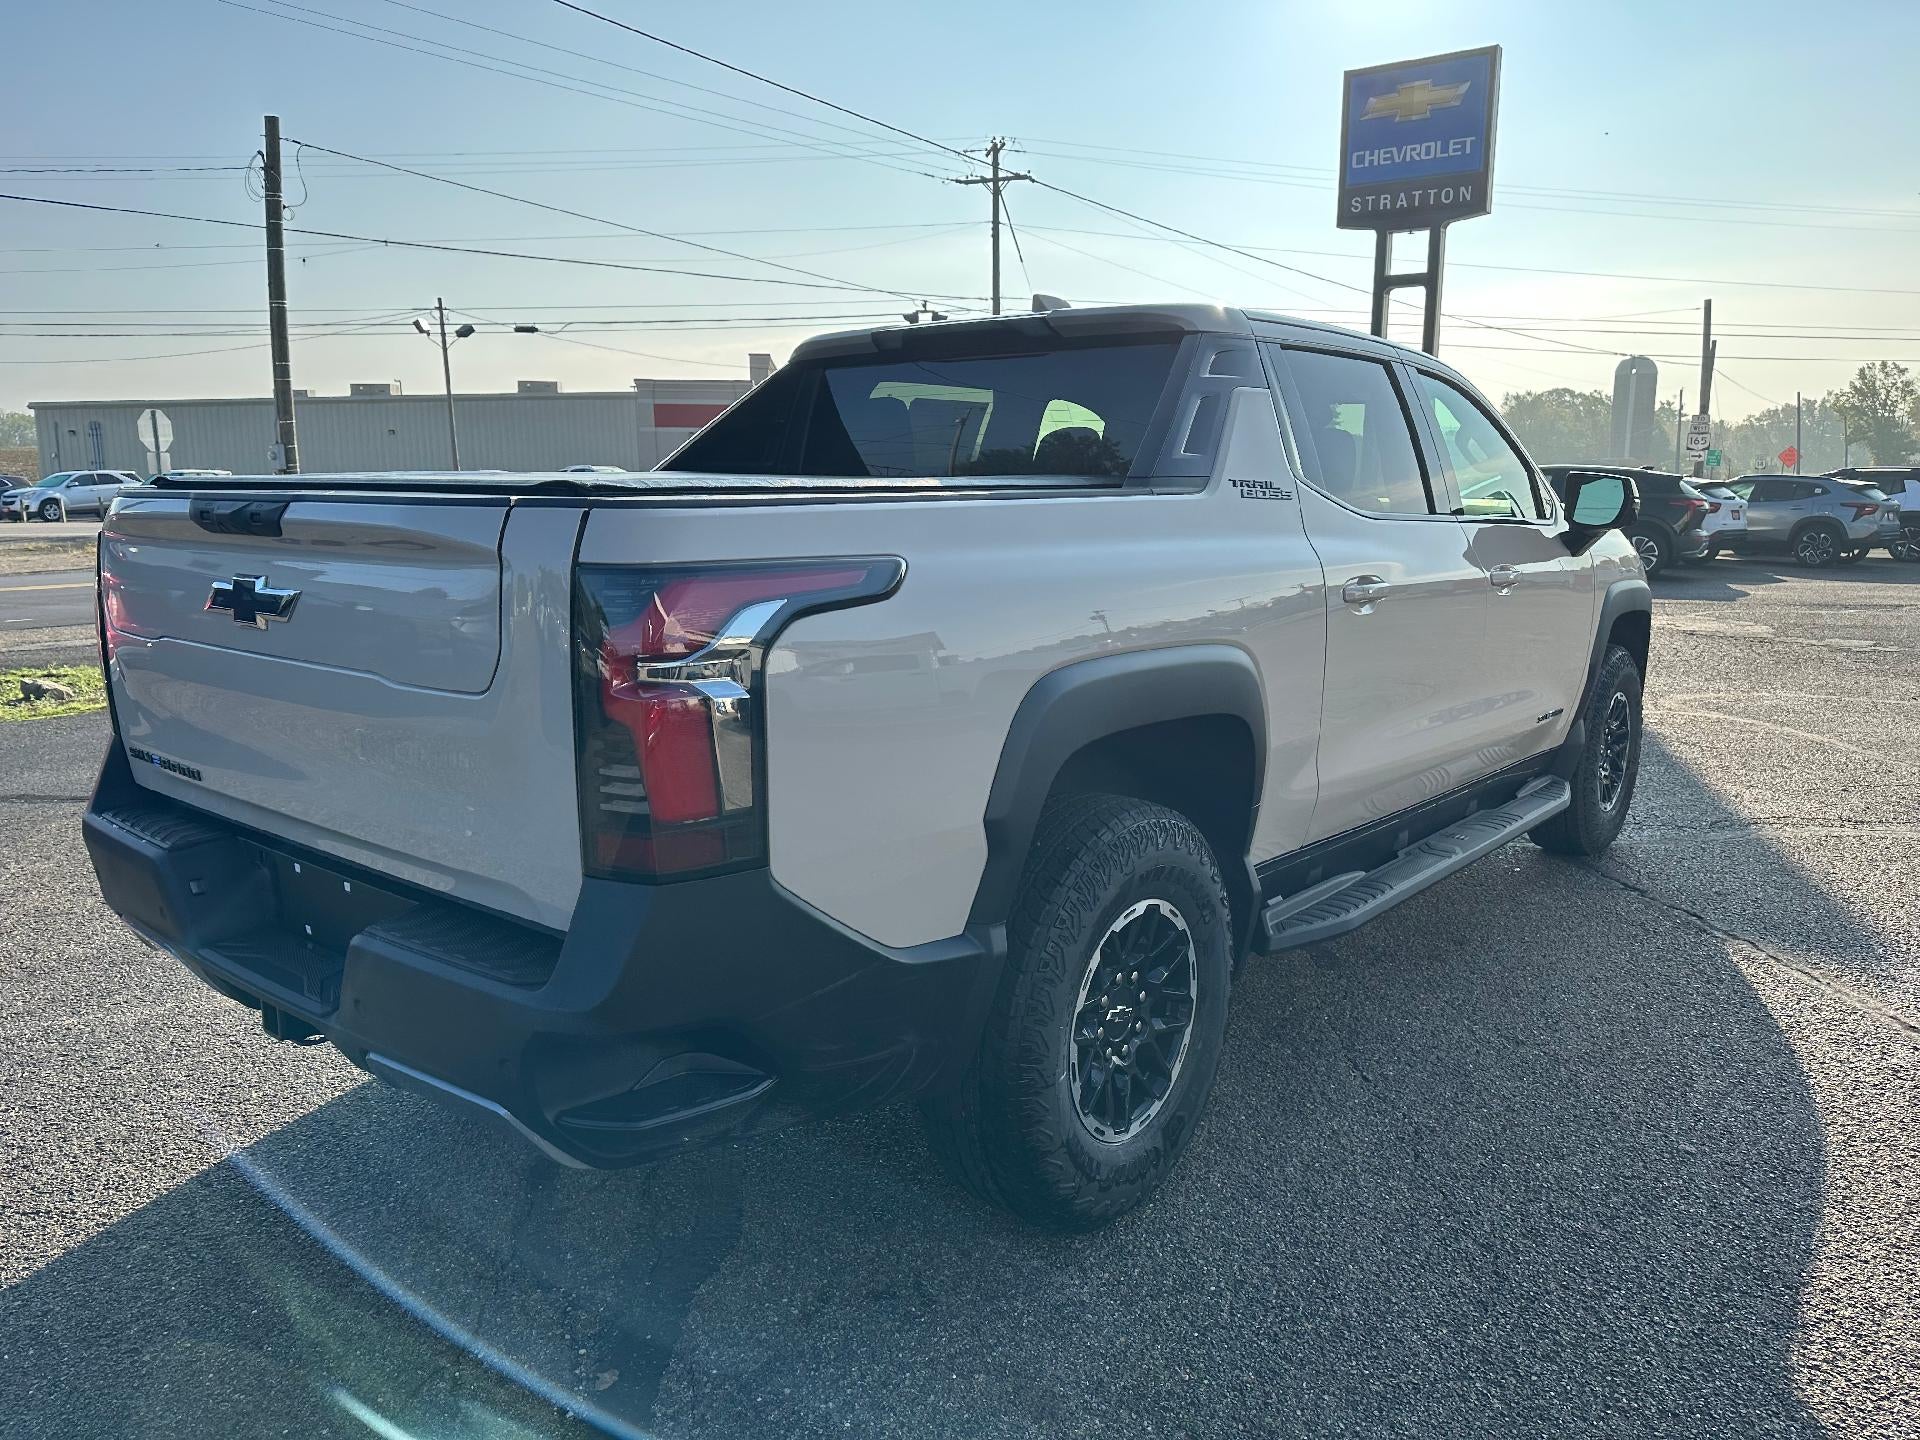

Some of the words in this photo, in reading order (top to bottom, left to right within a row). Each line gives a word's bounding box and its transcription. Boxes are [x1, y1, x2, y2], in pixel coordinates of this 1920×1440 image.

[1352, 136, 1475, 169] CHEVROLET
[1351, 185, 1472, 213] STRATTON
[1690, 436, 1707, 445] 165
[1228, 479, 1281, 490] TRAIL
[1240, 488, 1293, 500] BOSS
